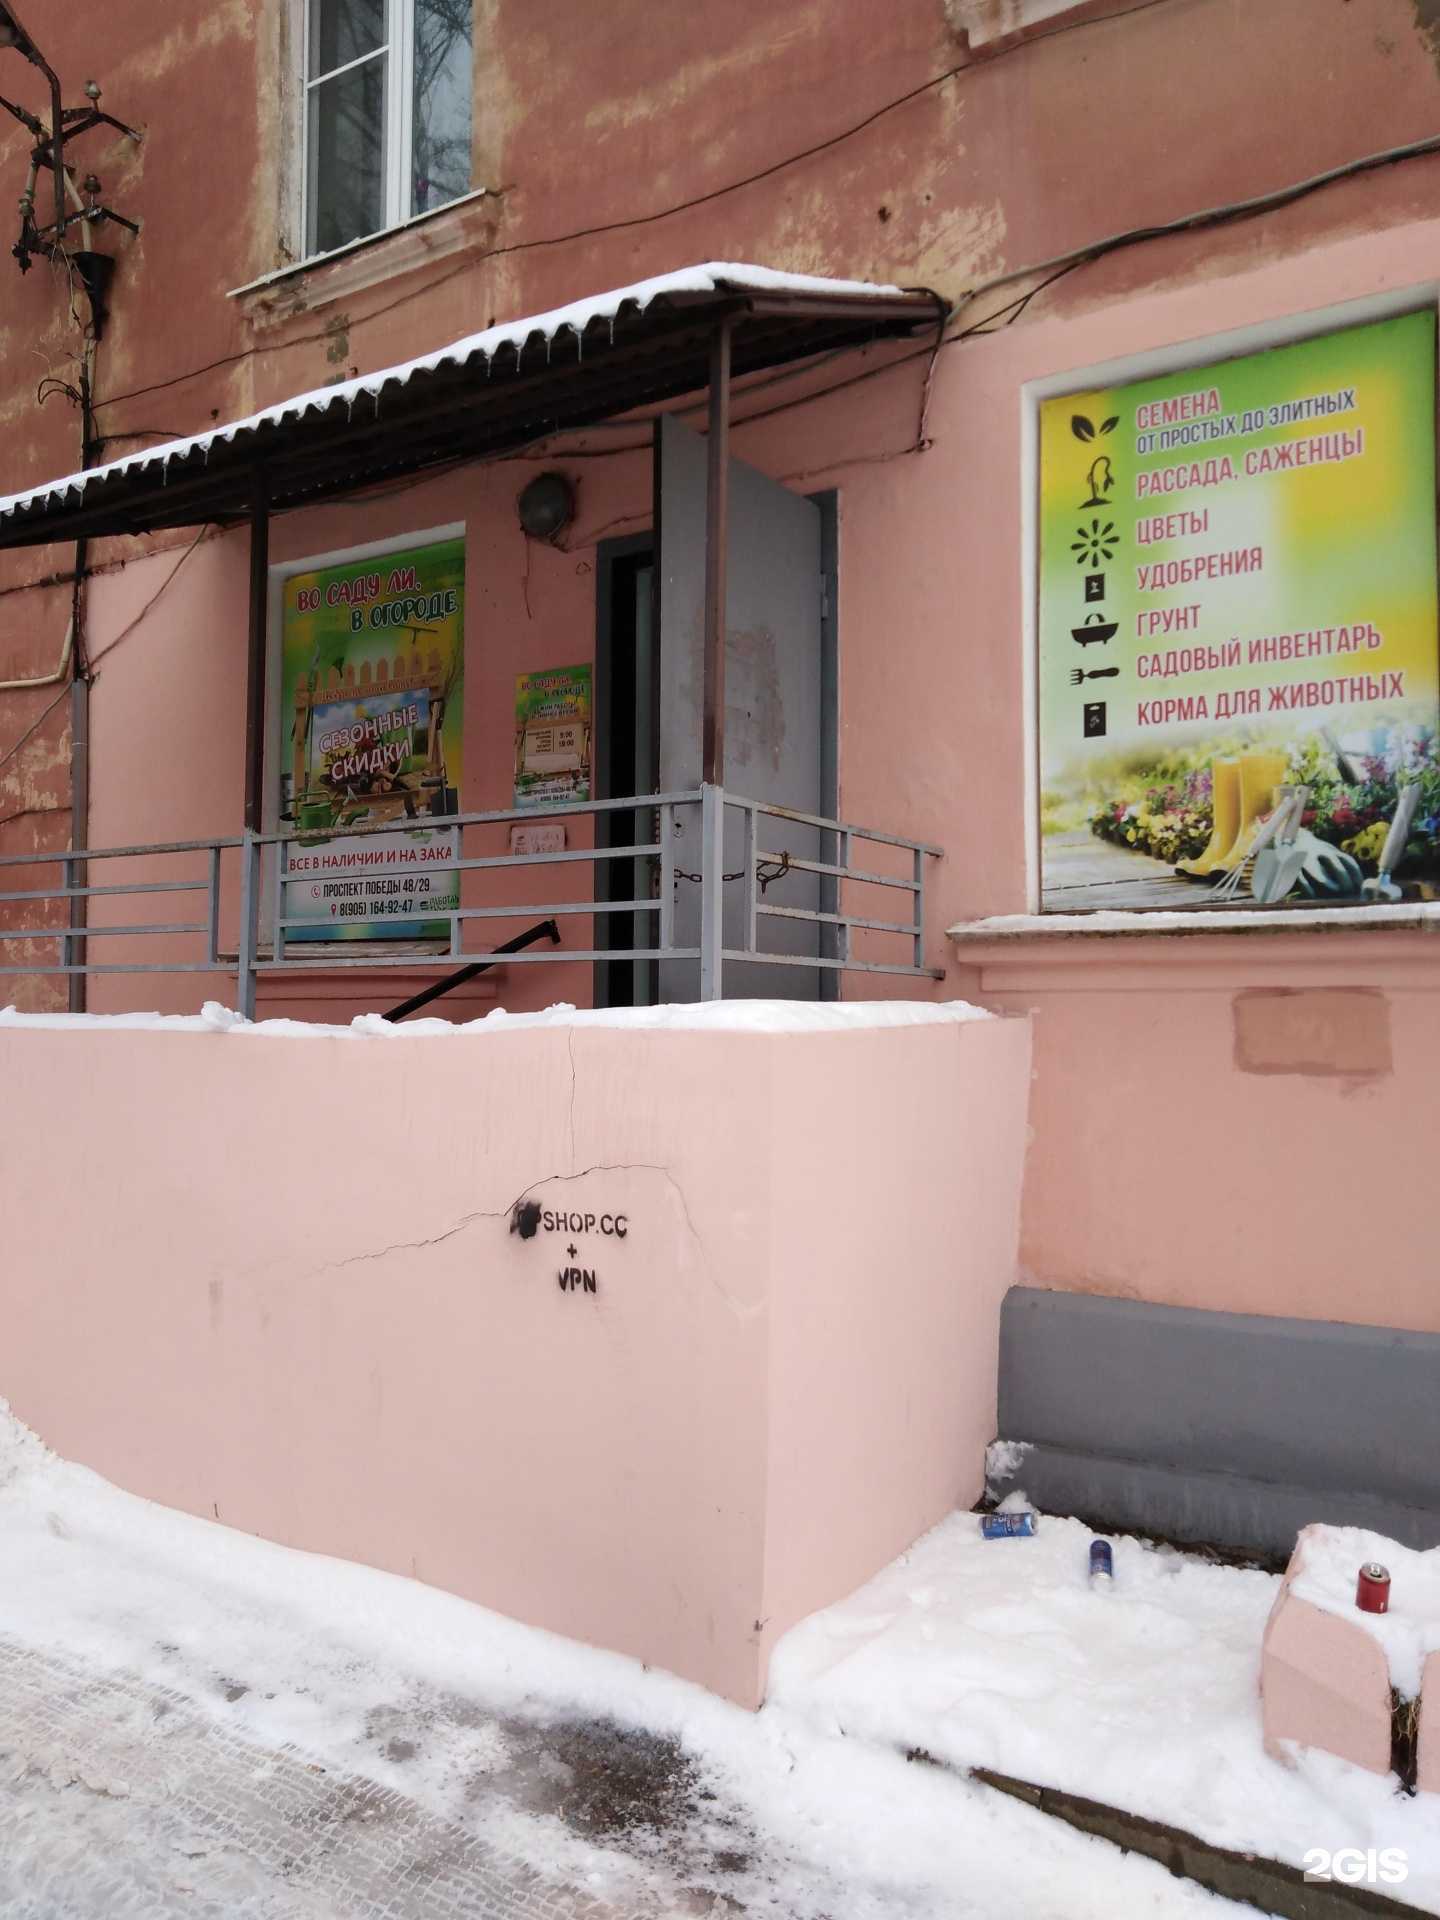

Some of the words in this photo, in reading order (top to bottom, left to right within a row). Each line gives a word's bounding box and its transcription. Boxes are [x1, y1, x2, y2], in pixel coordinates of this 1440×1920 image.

[1136, 389, 1220, 430] СЕМЕНА
[1136, 434, 1155, 454] ОТ
[1160, 416, 1236, 450] ПРОСТЫХ
[1241, 411, 1264, 435] ДО
[1268, 390, 1355, 426] ЭЛИТНЫХ
[1136, 458, 1239, 498] РАССАДА,
[1244, 429, 1363, 476] САЖЕНЦЫ
[1136, 509, 1209, 545] ЦВЕТЫ
[1136, 547, 1263, 590] УДОБРЕНИЯ
[297, 588, 321, 613] ВО
[326, 573, 380, 608] САДУ
[351, 608, 364, 633] В
[369, 589, 458, 629] ОГОРОДЕ
[1136, 604, 1202, 637] ГРУНТ
[1136, 637, 1241, 679] САДОВЫЙ
[1247, 623, 1382, 664] ИНВЕНТАРЬ
[1136, 697, 1209, 727] КОРМА
[1214, 689, 1261, 721] ДЛЯ
[1267, 672, 1405, 710] ЖИВОТНЫХ
[319, 704, 419, 753] СЕЗОННЫЕ
[331, 737, 413, 780] СКИДКИ
[289, 858, 312, 872] ВСЕ
[312, 857, 320, 869] В
[322, 851, 384, 868] НАЛИЧИИ
[386, 850, 396, 863] И
[399, 849, 417, 862] НА
[419, 846, 453, 861] ЗАКА
[323, 882, 364, 898] ПРОСПЕКТ
[365, 879, 401, 896] ПОБЕДЫ
[402, 878, 431, 893] 48/29
[339, 901, 367, 917] 8(905)
[369, 899, 413, 915] 164-92-47
[558, 1267, 597, 1293] VPN
